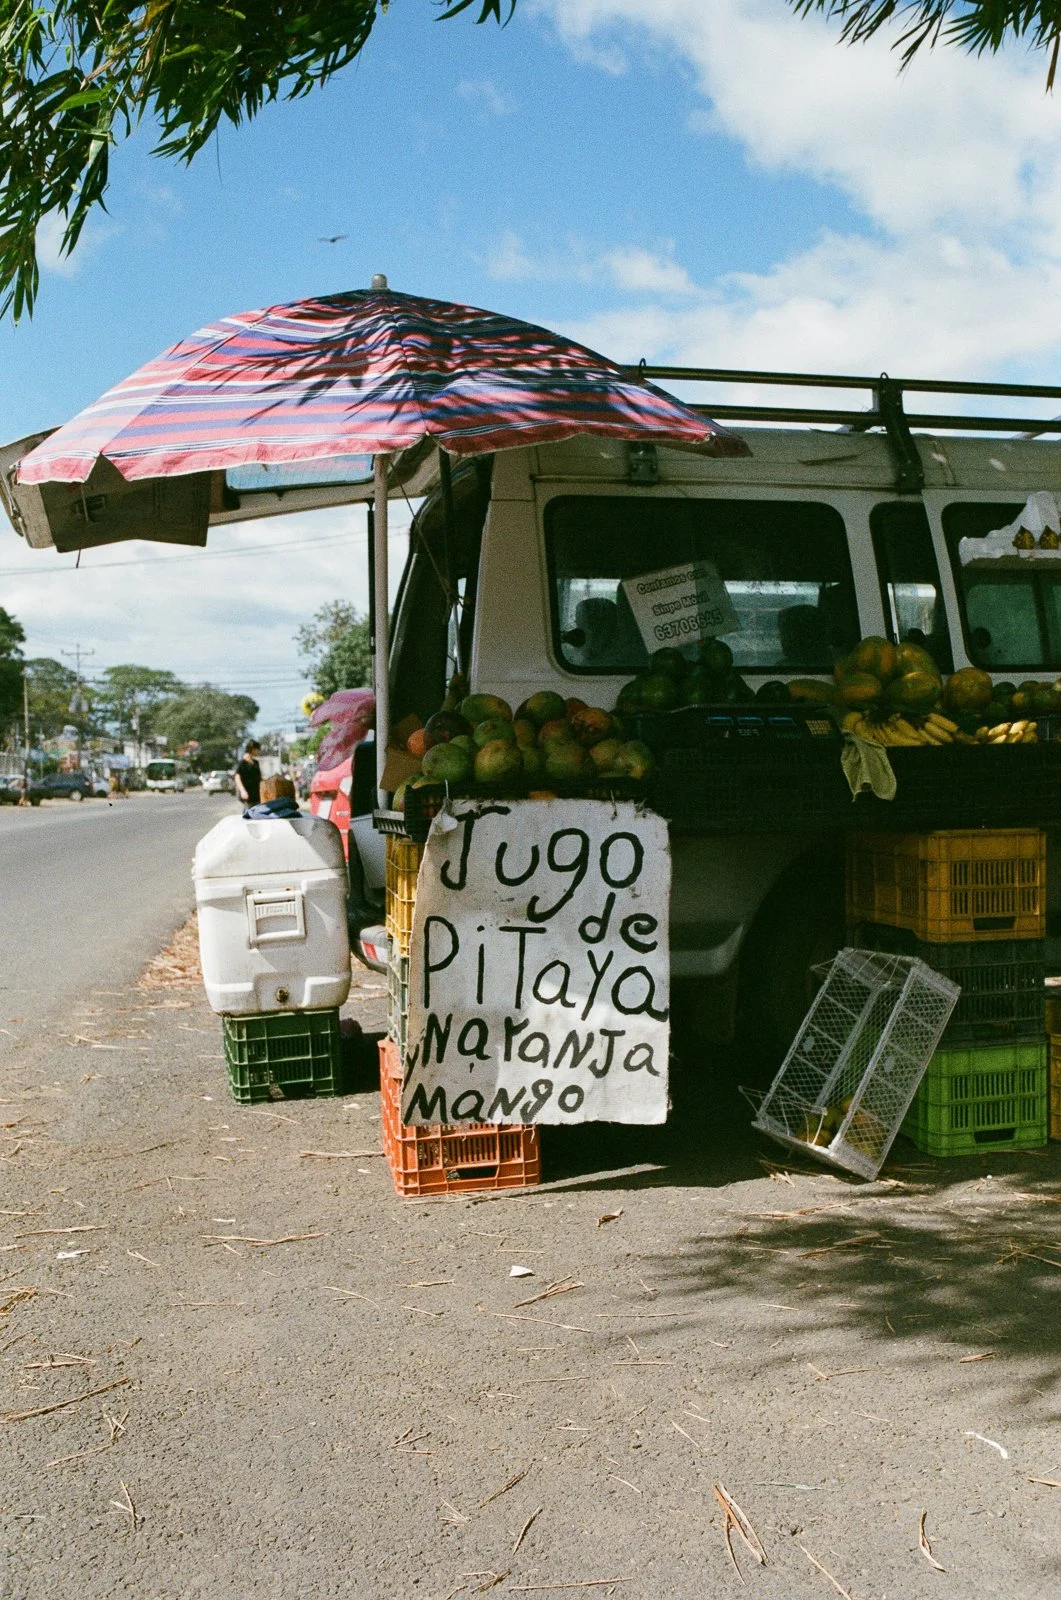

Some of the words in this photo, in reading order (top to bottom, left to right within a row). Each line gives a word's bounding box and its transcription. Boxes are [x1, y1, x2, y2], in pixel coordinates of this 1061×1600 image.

[637, 573, 687, 595] Contamos
[653, 600, 681, 616] Sinpe
[653, 608, 724, 641] 63706645
[440, 805, 645, 923] Jugo
[578, 892, 658, 954] de
